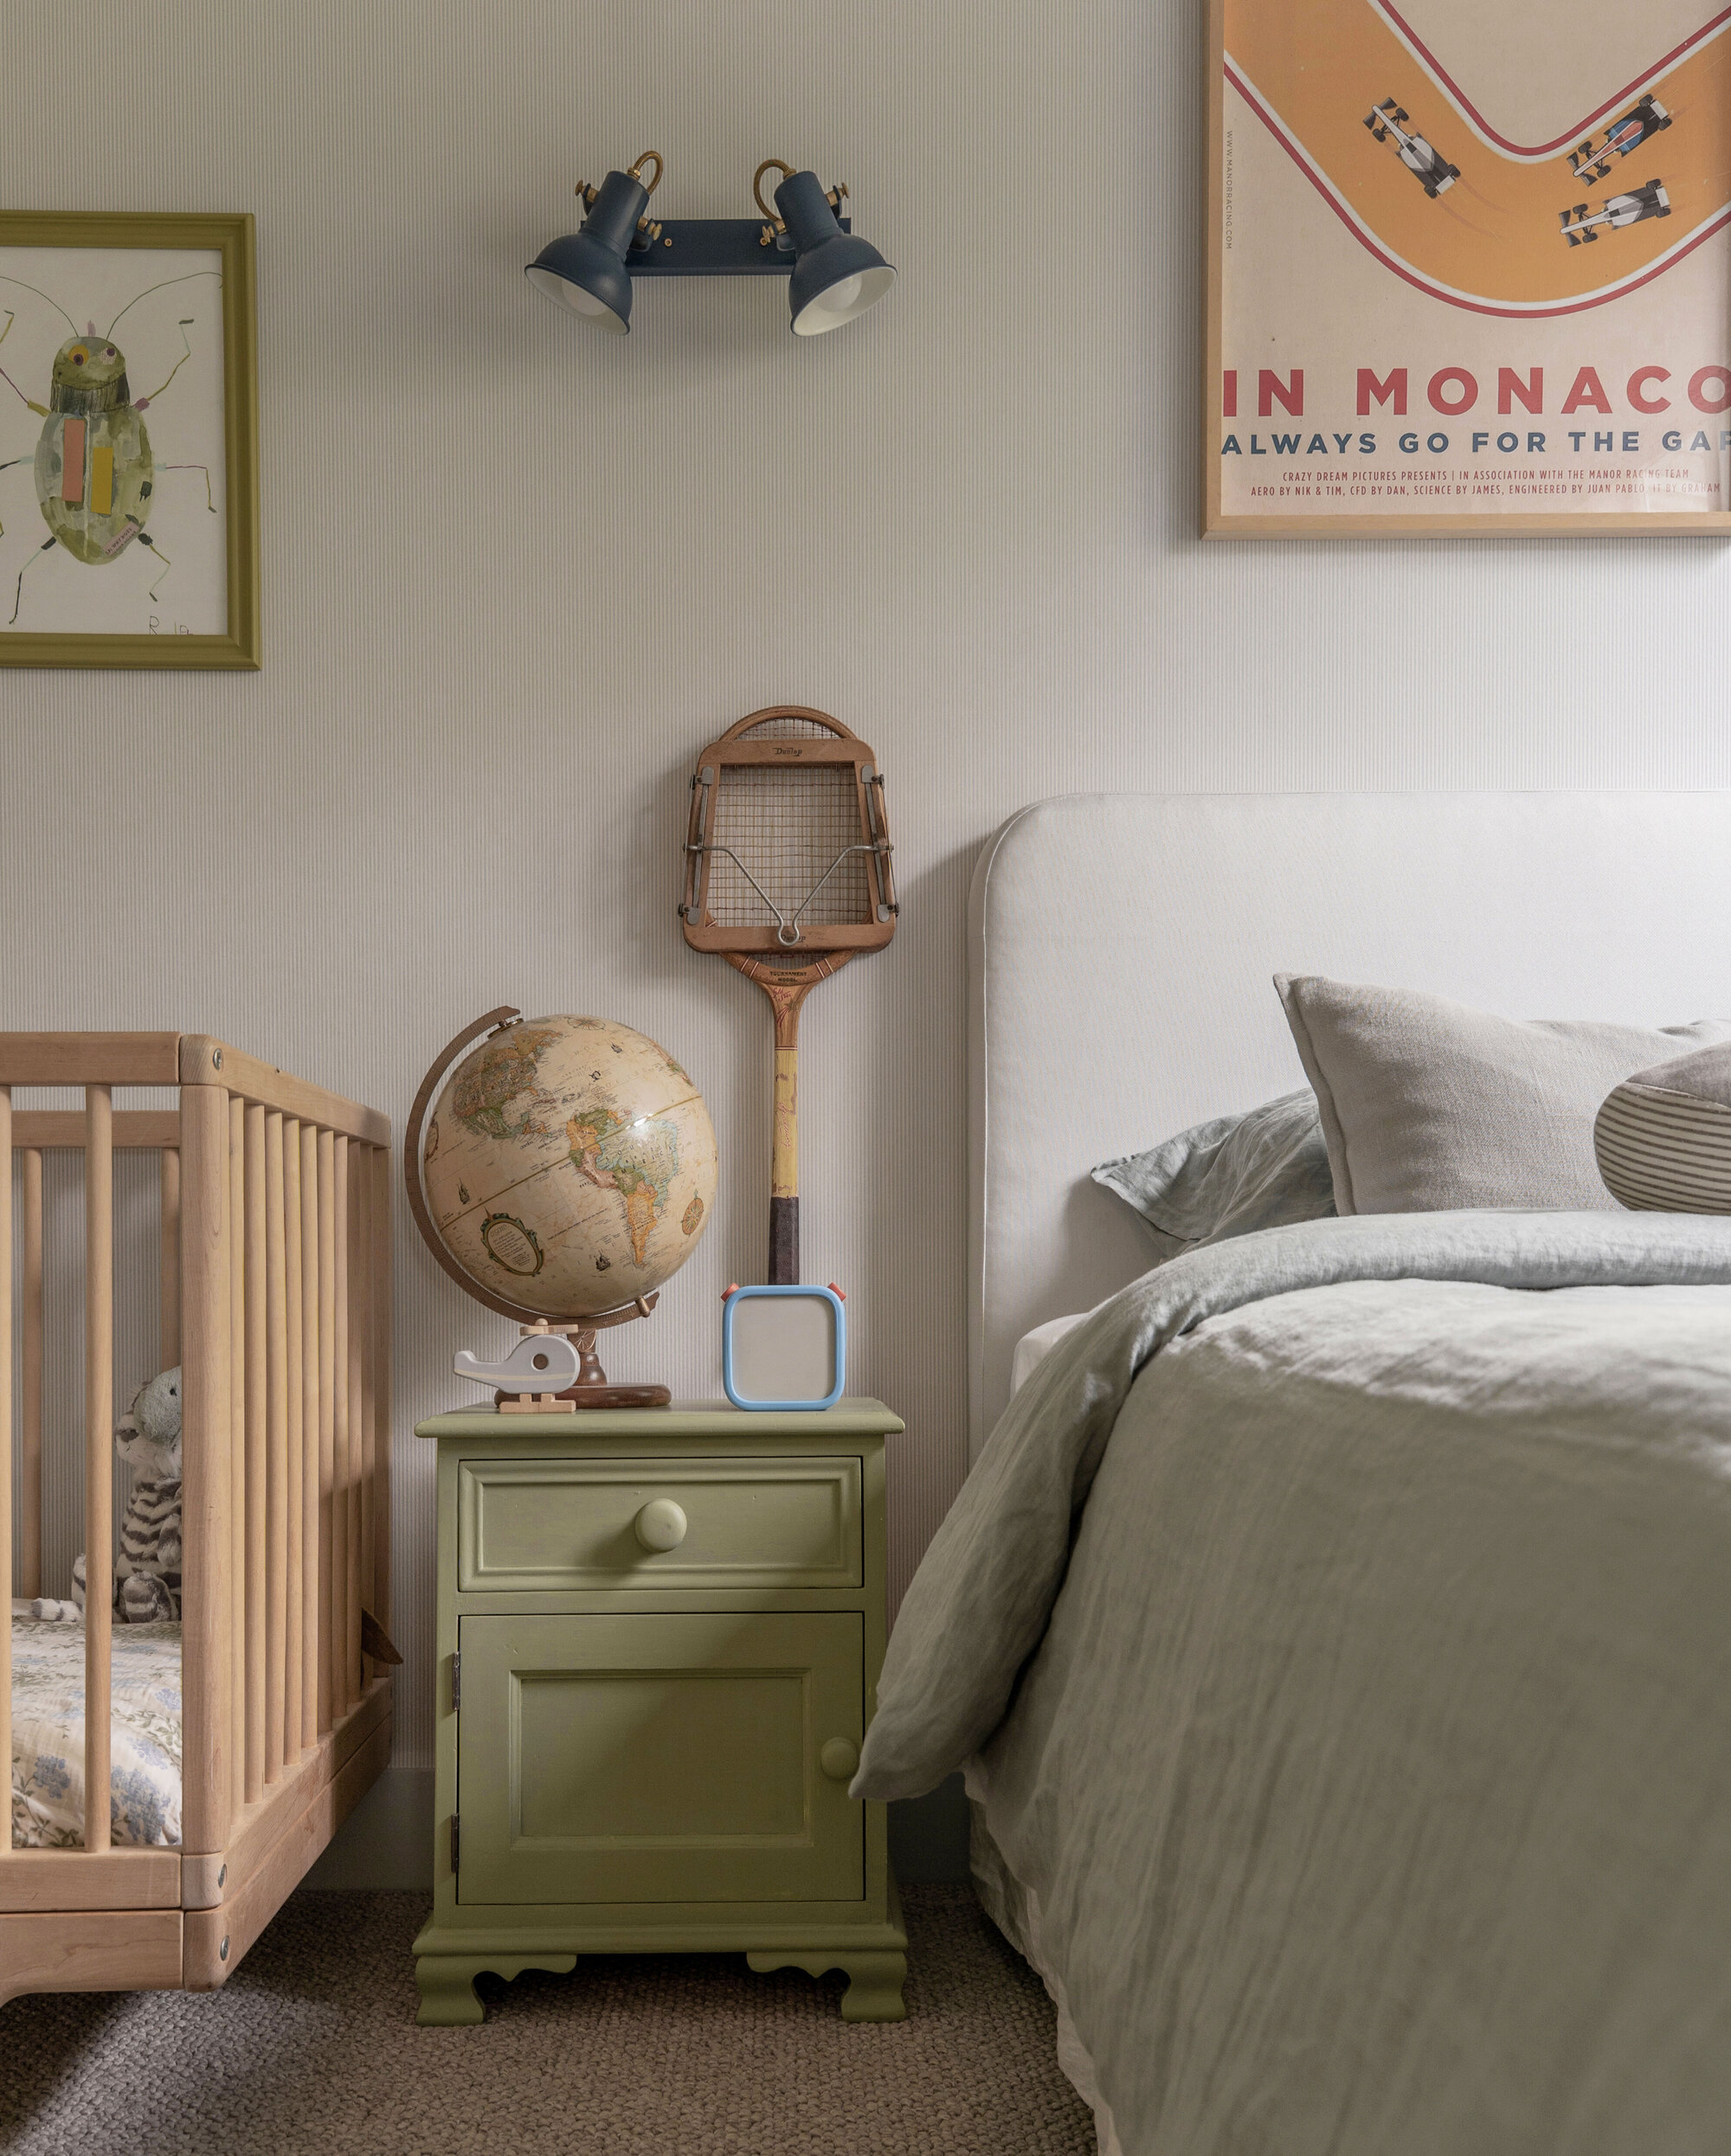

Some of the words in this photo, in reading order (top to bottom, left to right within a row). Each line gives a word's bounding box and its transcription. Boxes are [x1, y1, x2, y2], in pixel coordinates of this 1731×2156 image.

[1222, 370, 1304, 417] IN
[1356, 365, 1731, 415] MONACO
[1220, 433, 1376, 454] ALWAYS
[1398, 432, 1449, 454] GO
[1471, 431, 1547, 453] FOR
[1567, 431, 1640, 452] THE
[1283, 472, 1312, 482] CRAZY
[1316, 471, 1348, 482] DREAM
[1352, 471, 1397, 481] PICTURES
[1400, 470, 1447, 481] PRESENTS
[1459, 470, 1470, 481] IN
[1473, 470, 1535, 481] ASSOCIATION
[1539, 469, 1563, 480] WITH
[1568, 469, 1584, 480] THE
[1588, 469, 1622, 480] MANOR
[1625, 469, 1661, 479] RACING
[1664, 468, 1689, 479] TEAM
[1251, 486, 1275, 497] AERO
[1279, 486, 1290, 497] BY
[1295, 486, 1311, 497] NIK
[1315, 486, 1322, 496] &
[1326, 486, 1346, 497] TIM,
[1349, 486, 1367, 496] CFD
[1371, 485, 1382, 496] BY
[1387, 485, 1410, 497] DAN,
[1413, 485, 1451, 495] SCIENCE
[1456, 485, 1468, 495] BY
[1471, 484, 1505, 496] JAMES,
[1509, 484, 1567, 495] ENGINEERED
[1571, 484, 1583, 494] BY
[1587, 484, 1611, 494] JUAN
[1665, 483, 1676, 493] BY
[1681, 482, 1721, 493] GRAHAM
[772, 747, 802, 757] Dunlop
